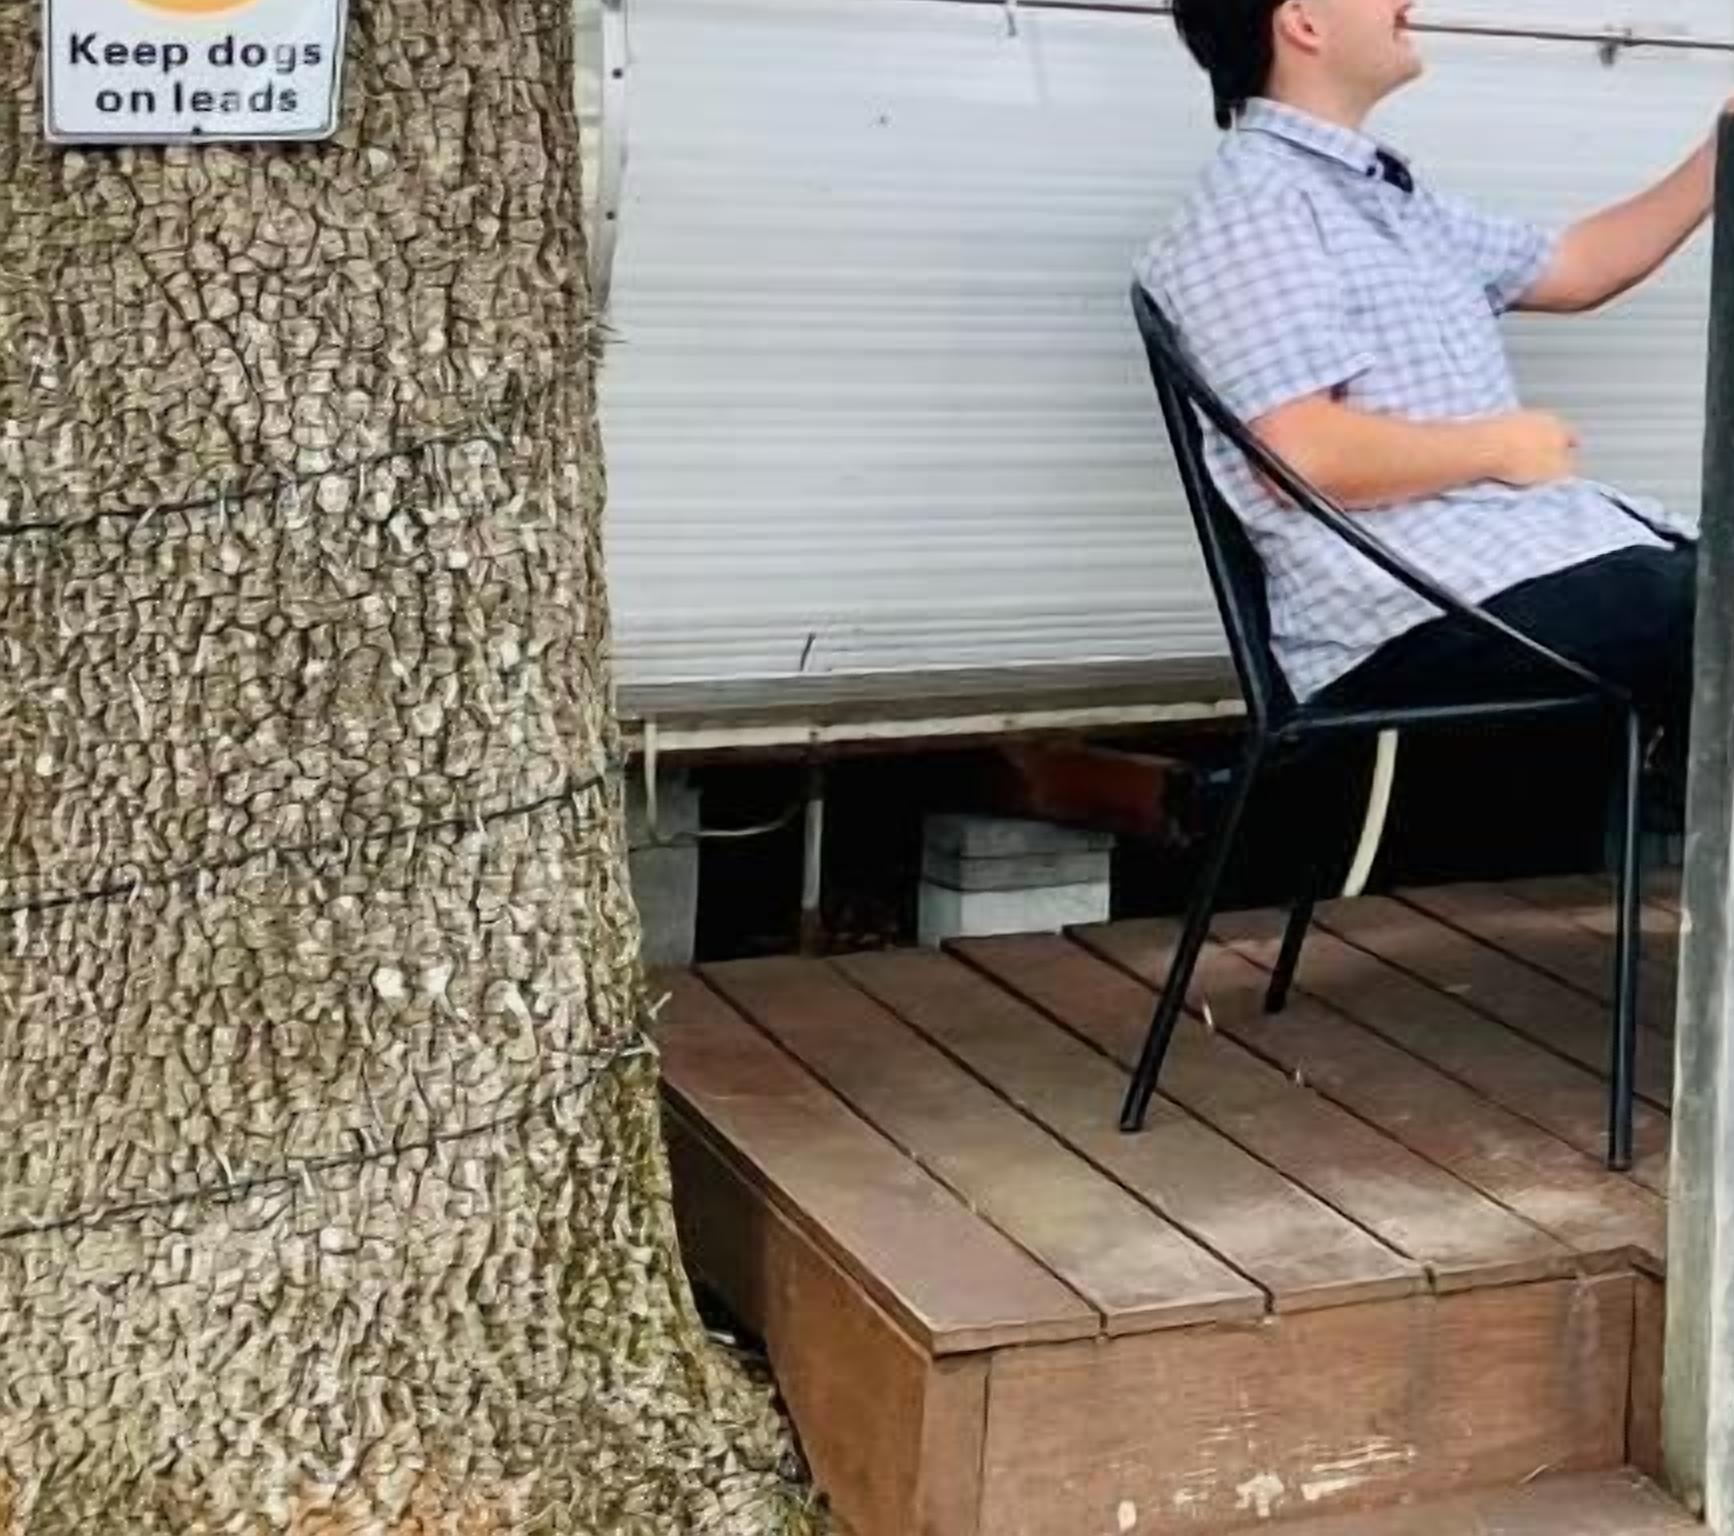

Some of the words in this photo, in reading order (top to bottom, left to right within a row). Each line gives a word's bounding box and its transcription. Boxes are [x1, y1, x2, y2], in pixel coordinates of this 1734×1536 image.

[69, 32, 189, 74] Keep
[207, 34, 321, 74] dogs
[95, 89, 156, 113] on
[173, 80, 298, 113] leads
